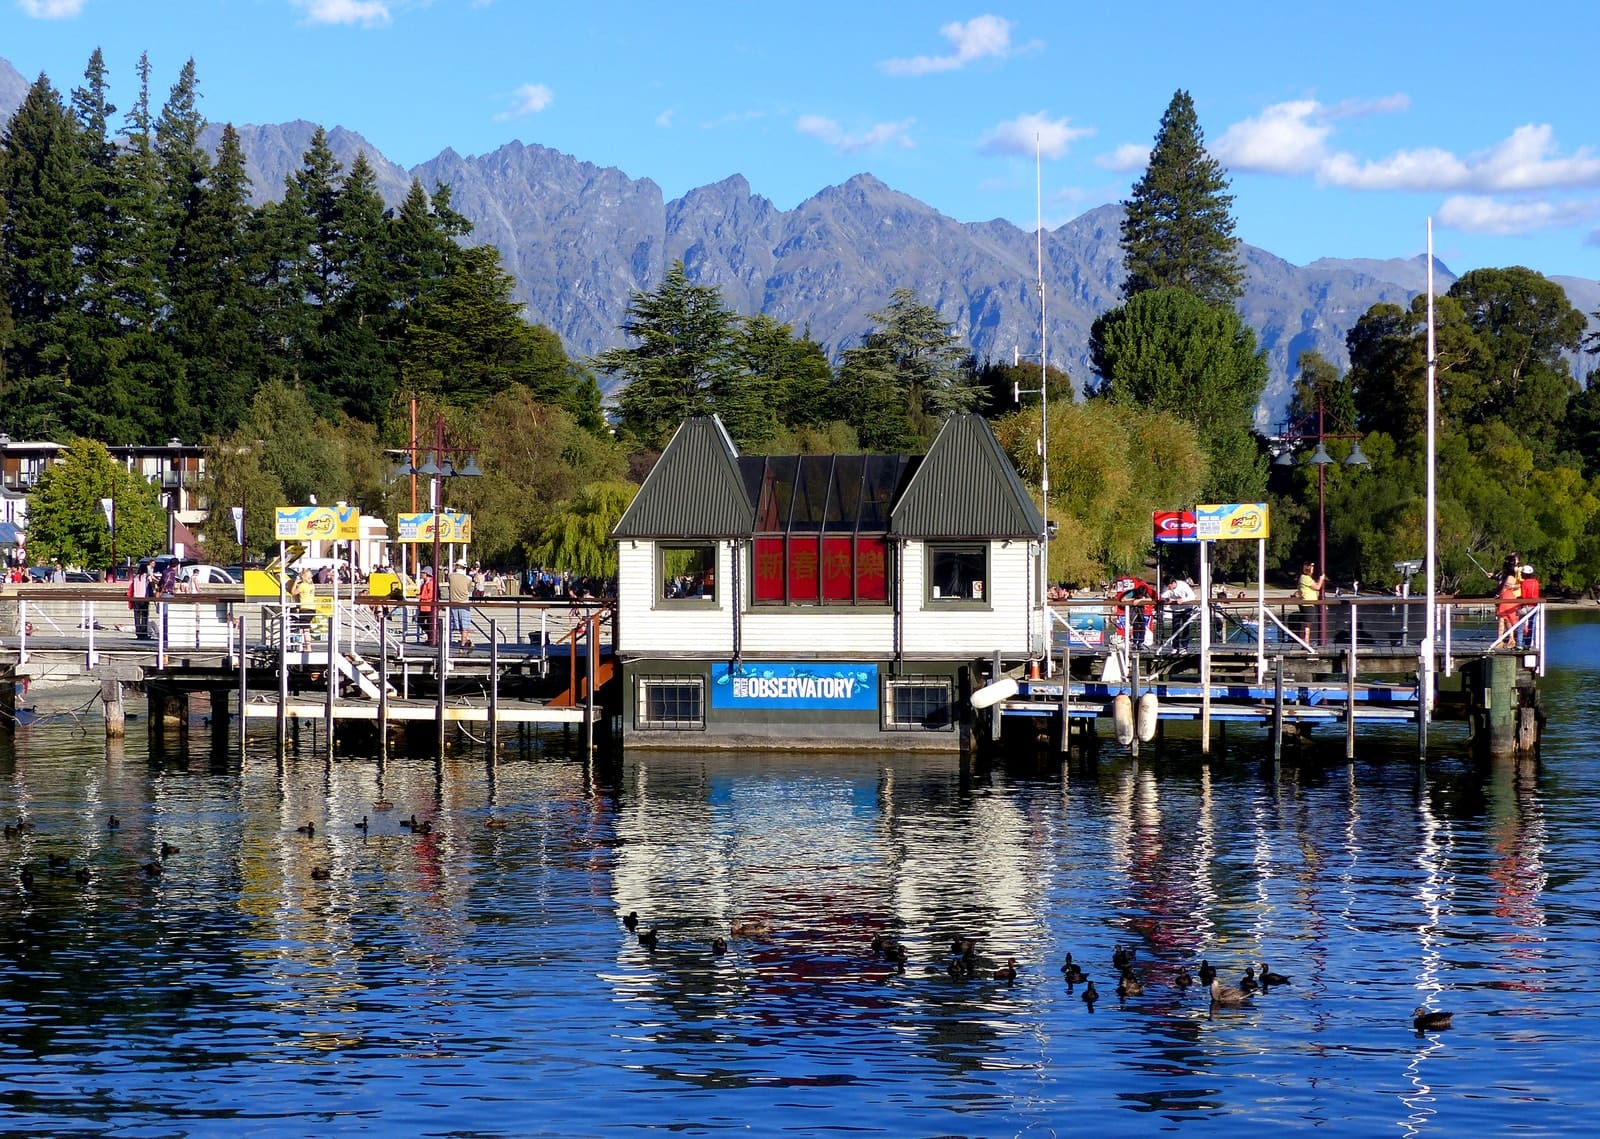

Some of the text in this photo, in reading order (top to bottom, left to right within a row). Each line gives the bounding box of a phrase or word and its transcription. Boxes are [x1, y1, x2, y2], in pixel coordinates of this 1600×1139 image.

[758, 550, 884, 580] 新春快樂
[748, 677, 855, 699] OBSERVATORY
